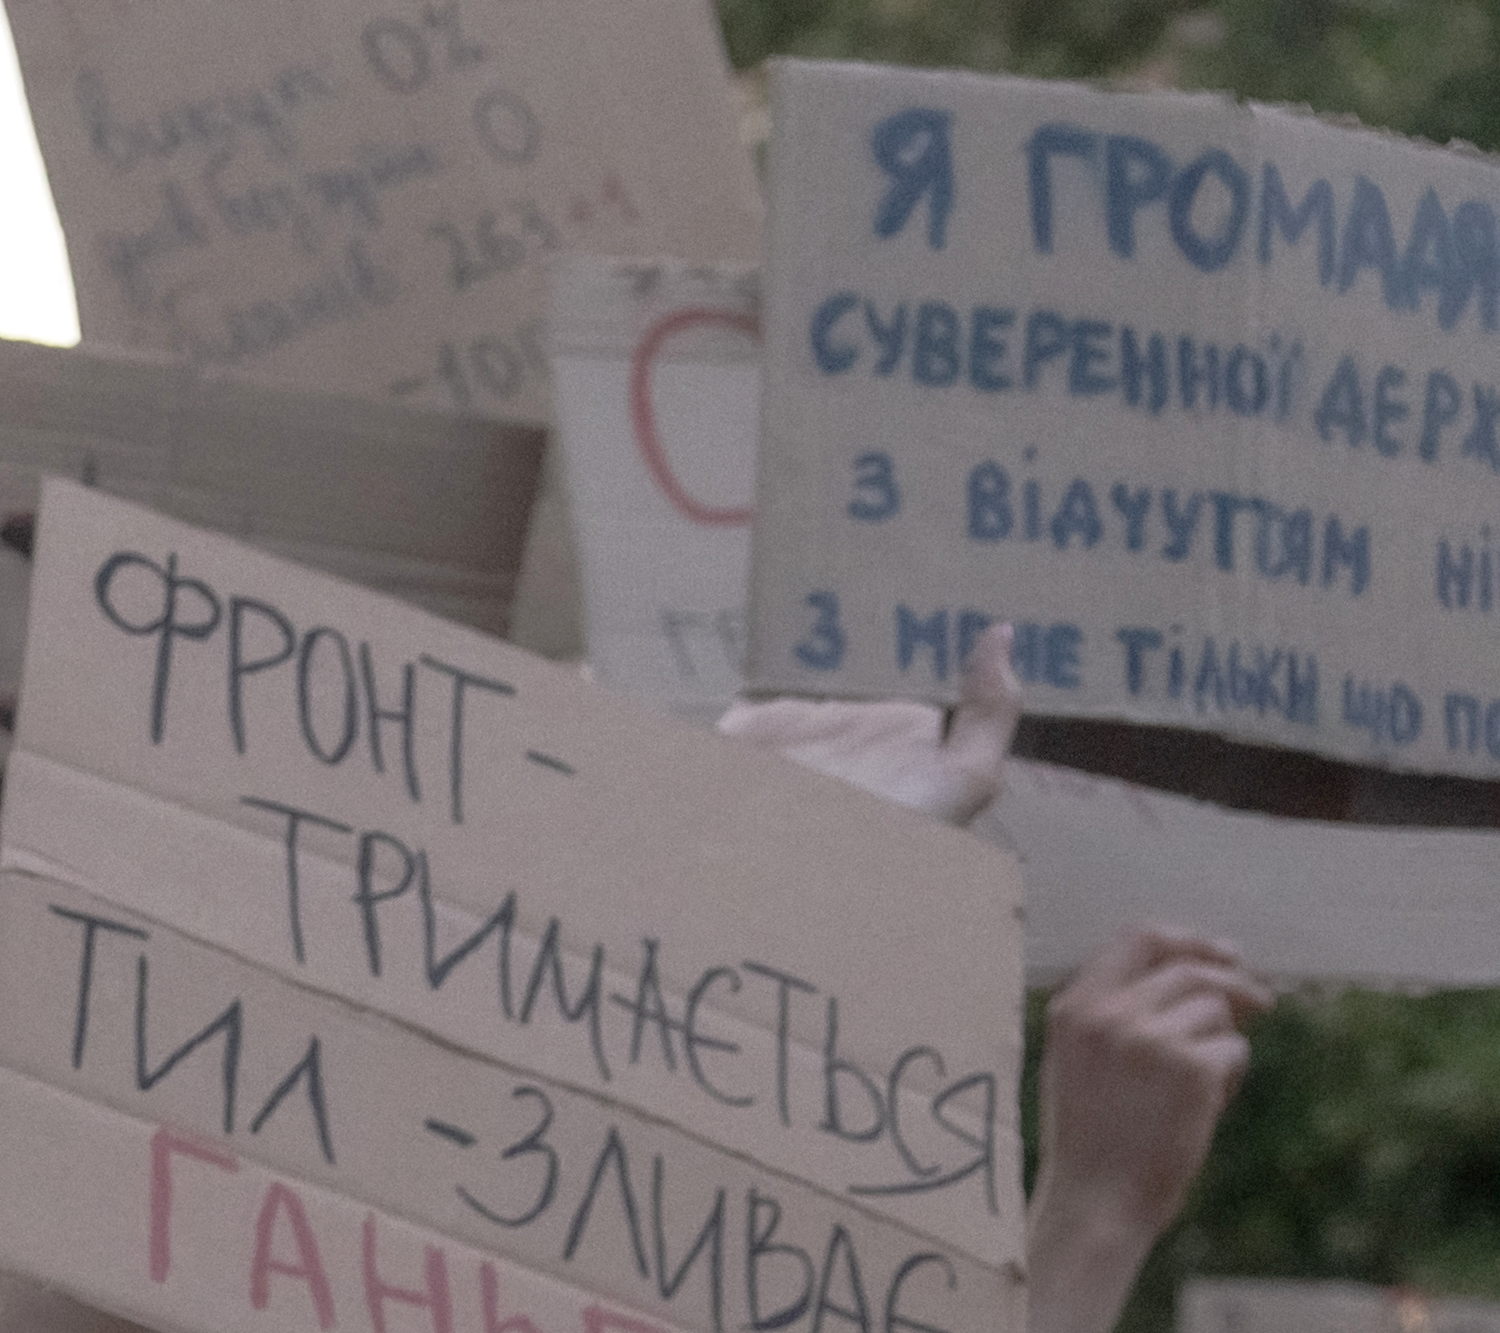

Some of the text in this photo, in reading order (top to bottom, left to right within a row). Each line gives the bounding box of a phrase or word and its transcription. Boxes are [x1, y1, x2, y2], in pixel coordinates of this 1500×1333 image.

[870, 106, 956, 252] Я
[847, 451, 901, 523] З
[793, 591, 846, 670] З
[49, 903, 338, 1168] ТИЛ
[240, 798, 1000, 1218] ТРИМАЄТЬСЯ
